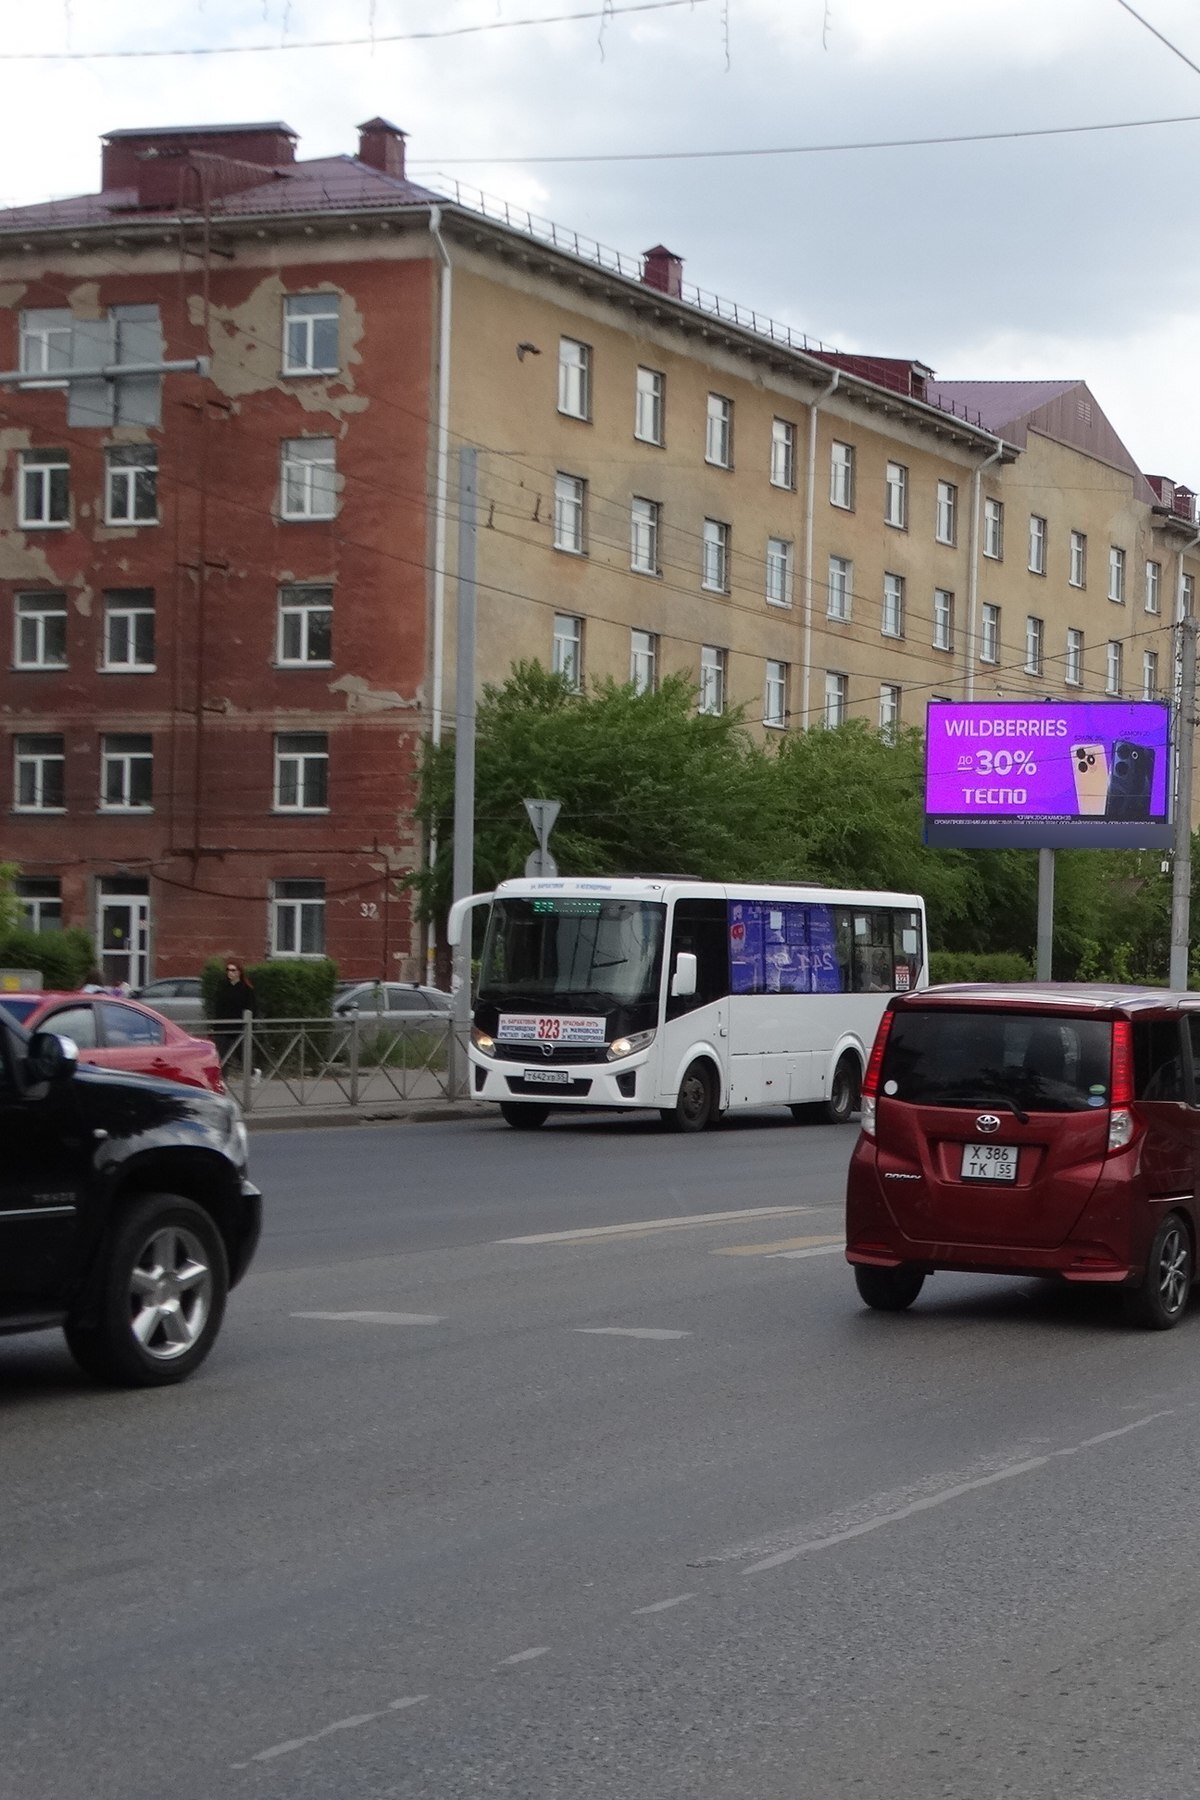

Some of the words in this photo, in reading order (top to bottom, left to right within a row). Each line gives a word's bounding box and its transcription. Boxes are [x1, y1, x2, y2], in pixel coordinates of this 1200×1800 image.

[945, 719, 1068, 737] WILDBERRIES
[961, 788, 1027, 804] TECNO
[360, 902, 379, 918] 32
[538, 1018, 560, 1039] 323
[985, 1147, 1009, 1160] 386
[999, 1164, 1012, 1174] 55
